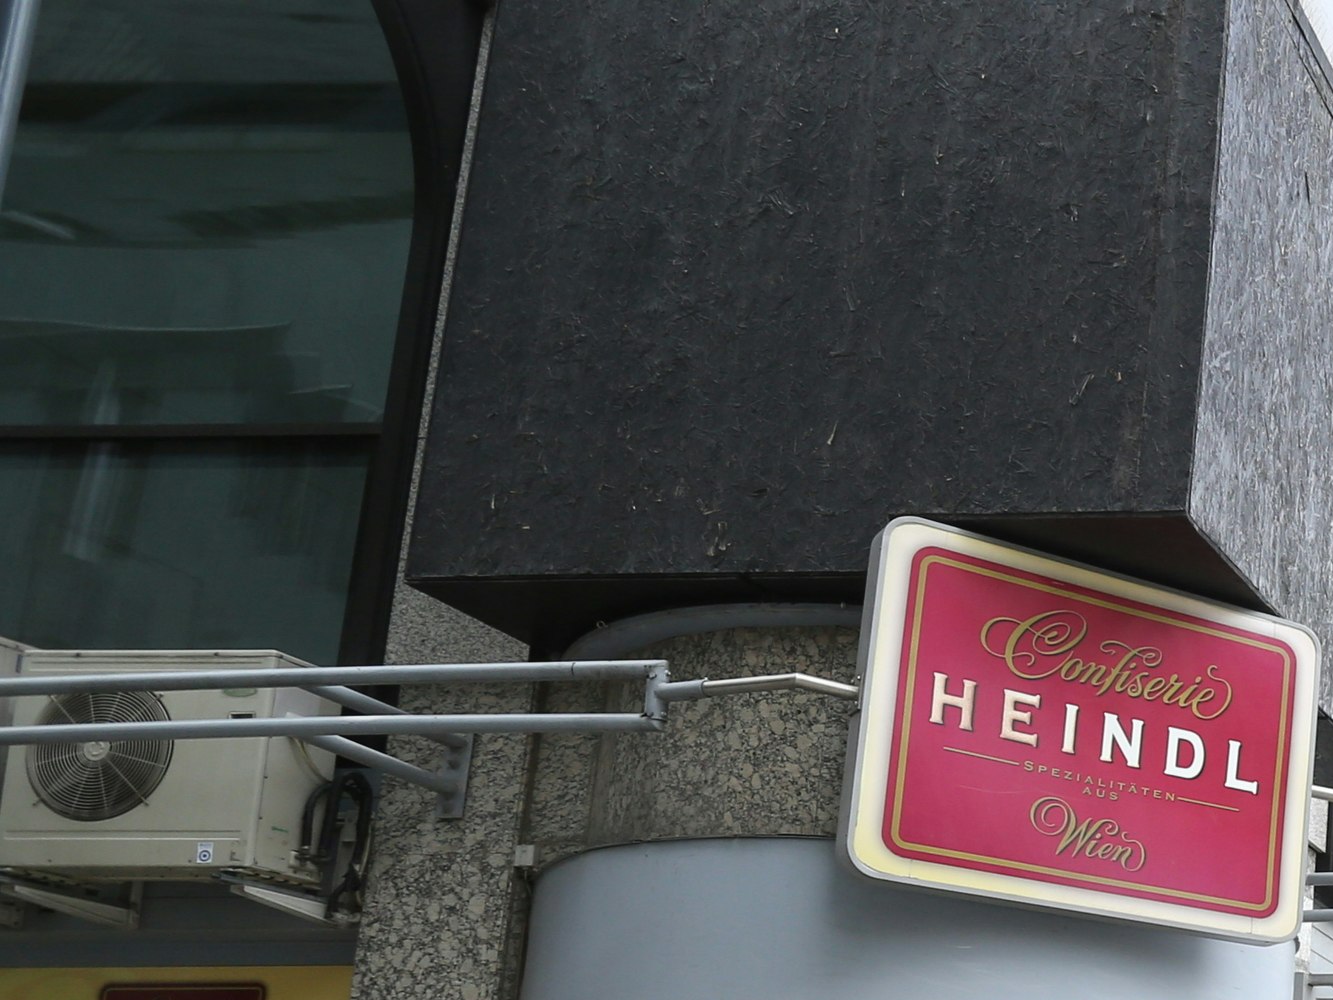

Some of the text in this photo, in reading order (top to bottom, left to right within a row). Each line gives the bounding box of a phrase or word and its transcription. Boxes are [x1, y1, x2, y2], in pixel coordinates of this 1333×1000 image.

[980, 610, 1232, 719] Confiserie
[929, 671, 1259, 795] HEINDL
[1023, 760, 1177, 802] SPEZIALITÄTEN
[1082, 785, 1119, 801] AUS
[1029, 796, 1146, 872] Wien
